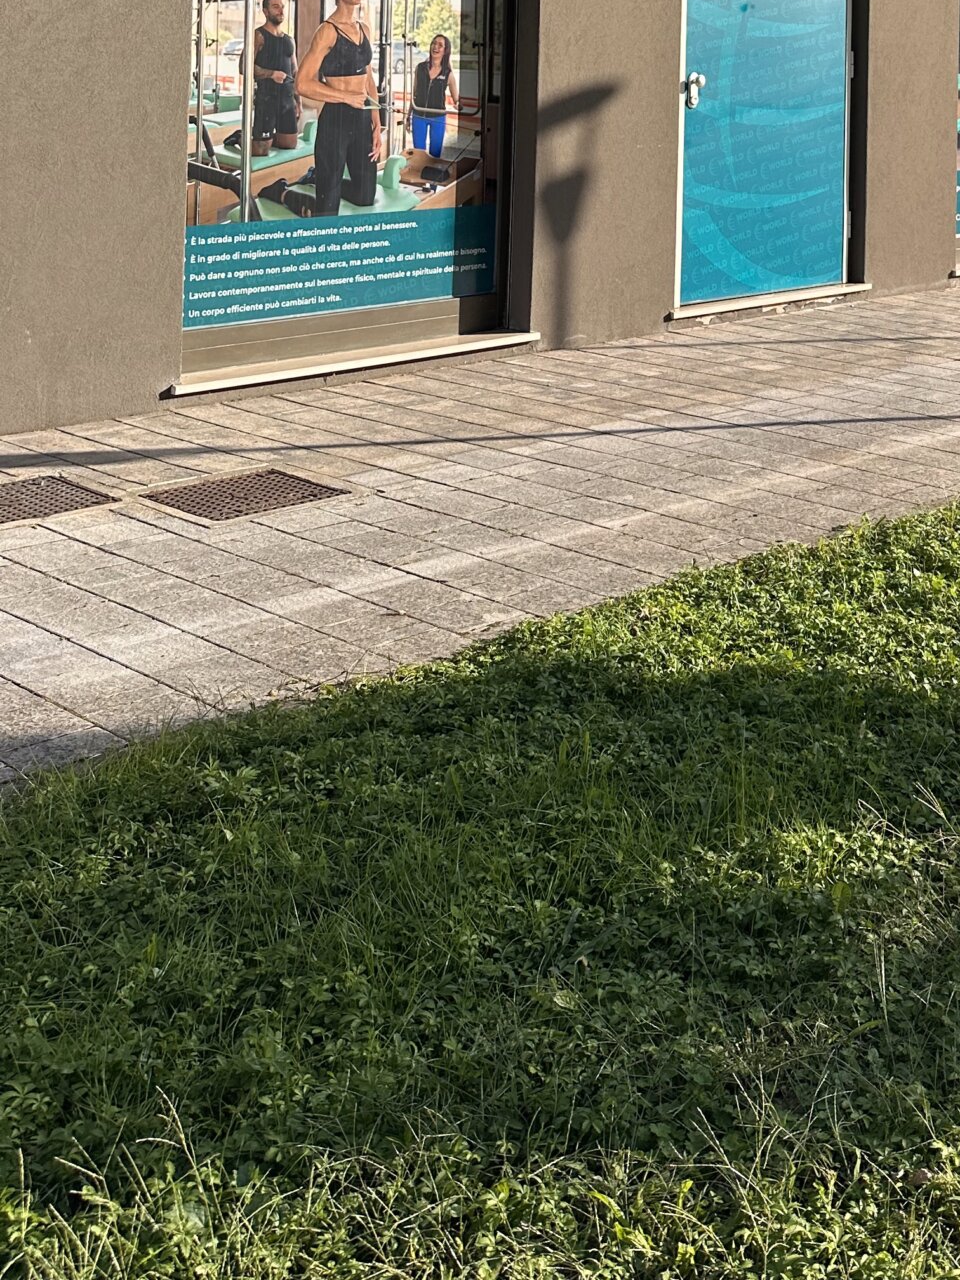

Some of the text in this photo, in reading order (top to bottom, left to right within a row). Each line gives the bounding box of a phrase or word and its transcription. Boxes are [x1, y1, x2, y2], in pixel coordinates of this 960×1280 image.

[198, 236, 205, 245] la
[207, 234, 232, 244] strada
[234, 233, 247, 244] più
[248, 230, 284, 242] piacevole
[292, 227, 338, 237] affascinante
[339, 226, 353, 234] che
[354, 224, 372, 234] porta
[374, 223, 381, 231] al
[382, 221, 418, 230] benessere.
[197, 254, 205, 263] in
[207, 252, 230, 264] grado
[232, 250, 240, 260] di
[242, 248, 281, 260] migliorare
[283, 247, 290, 255] la
[291, 244, 317, 256] qualità
[318, 243, 326, 252] di
[327, 243, 340, 251] vita
[342, 241, 360, 251] delle
[361, 240, 390, 251] persone.
[190, 271, 206, 282] Può
[207, 270, 225, 280] dare
[234, 267, 264, 279] ognuno
[265, 267, 280, 276] non
[282, 264, 297, 273] solo
[299, 262, 310, 271] ciò
[311, 262, 325, 270] che
[327, 260, 348, 269] cerca,
[362, 256, 384, 264] anche
[385, 254, 396, 263] ciò
[397, 253, 404, 261] di
[405, 252, 415, 260] cui
[416, 251, 425, 259] ha
[426, 248, 459, 259] realmente
[189, 291, 216, 300] Lavora
[218, 282, 303, 297] contemporaneamente
[304, 280, 315, 288] sul
[317, 276, 353, 286] benessere
[355, 274, 376, 283] fisico,
[377, 270, 405, 280] mentale
[412, 266, 442, 278] spirituale
[443, 265, 459, 273] della
[188, 294, 342, 318] Un corpo efficiente può cambiarti la vita.
